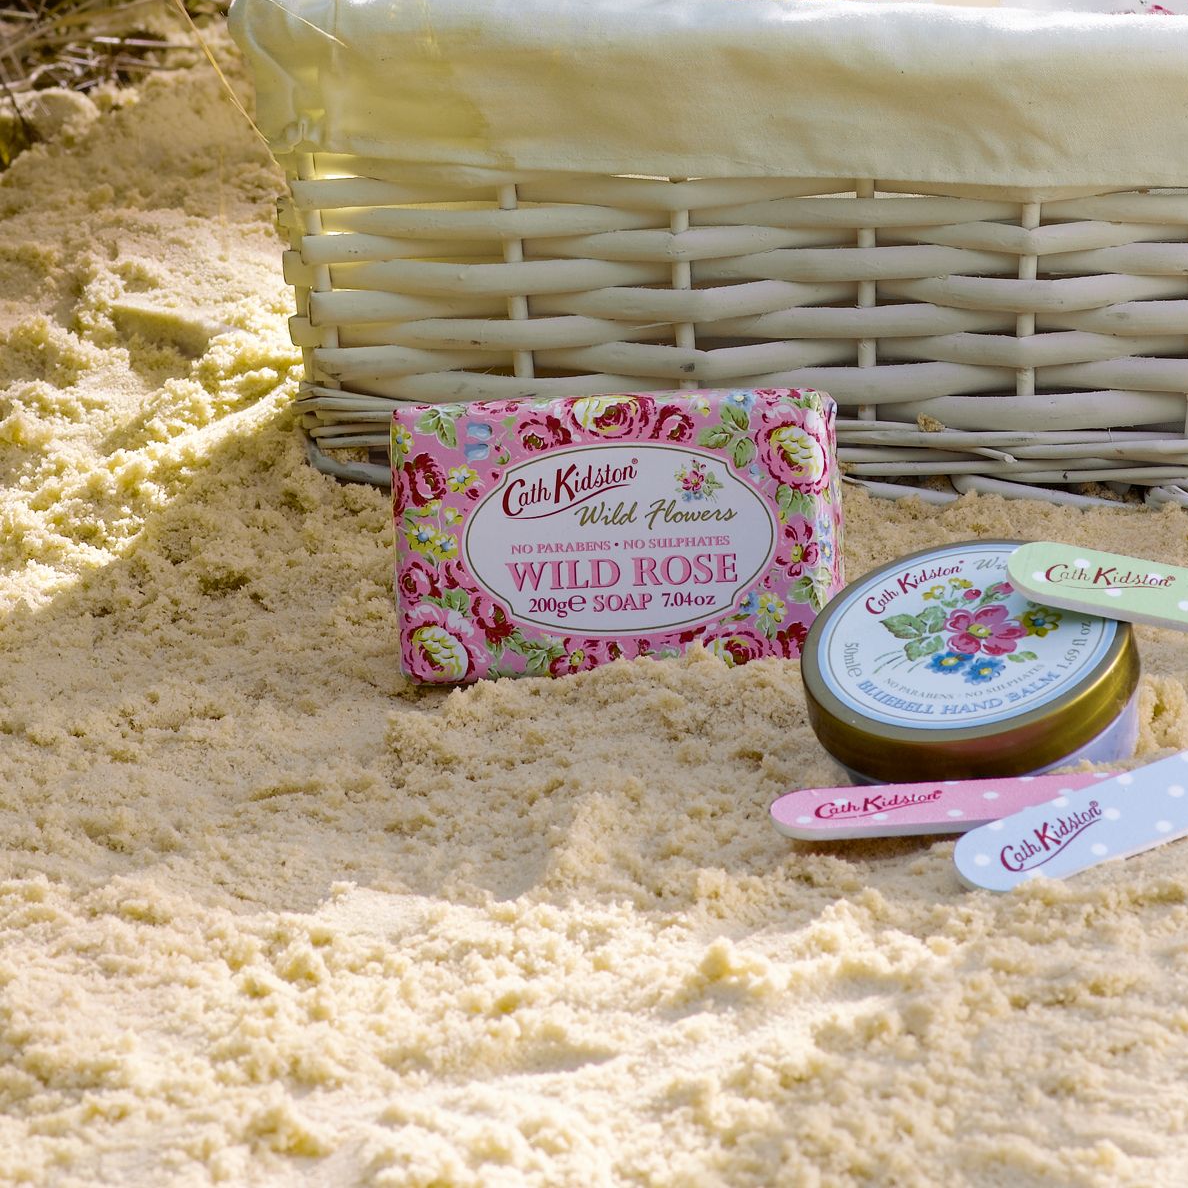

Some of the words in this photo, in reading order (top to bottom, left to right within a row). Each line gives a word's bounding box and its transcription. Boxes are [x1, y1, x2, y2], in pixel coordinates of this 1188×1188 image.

[502, 478, 552, 517] Cath
[554, 464, 638, 504] Kidston
[574, 503, 637, 526] Wild
[645, 499, 738, 530] Flowers
[511, 544, 534, 555] NO
[537, 540, 611, 553] PARABENS
[623, 539, 646, 550] NO
[648, 535, 730, 549] SULPHATES
[505, 559, 621, 593] WILD
[632, 553, 738, 587] ROSE
[865, 589, 899, 615] Cath
[897, 565, 963, 594] Kidston
[1045, 563, 1090, 583] Cath
[1093, 566, 1172, 588] Kidston
[593, 593, 653, 613] SOAP
[857, 679, 934, 714] BLUEBELL
[940, 698, 1003, 715] HAND
[1005, 671, 1061, 703] BALM
[1057, 648, 1080, 670] 1.69
[1080, 620, 1092, 636] oz
[814, 802, 860, 819] Cath
[862, 791, 938, 812] Kidston
[1000, 840, 1042, 872] Cath
[1033, 805, 1102, 852] Kidston
